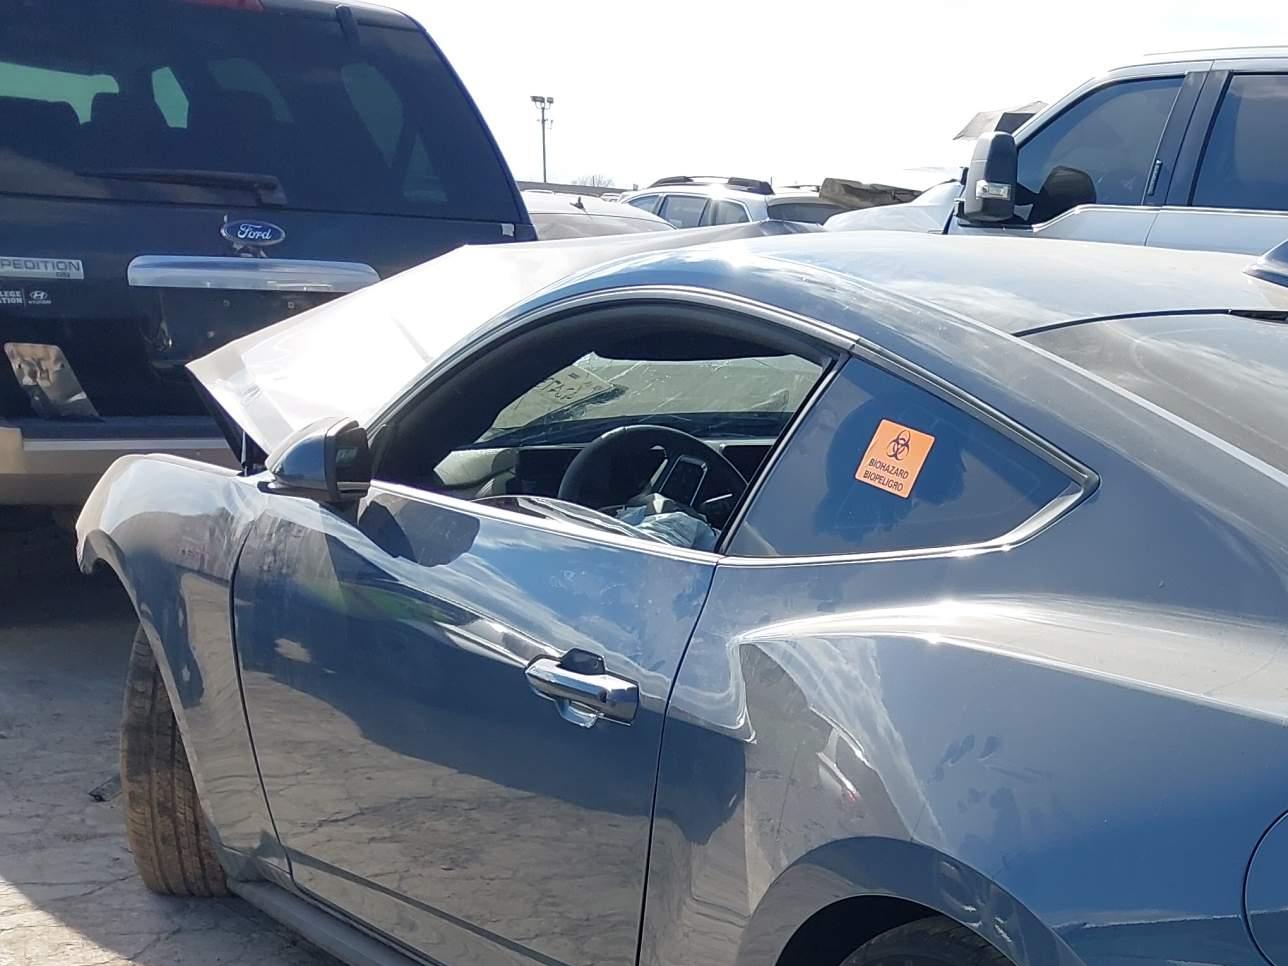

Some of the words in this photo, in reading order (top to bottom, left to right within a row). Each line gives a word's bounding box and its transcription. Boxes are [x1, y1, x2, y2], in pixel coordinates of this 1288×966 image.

[237, 223, 272, 239] Ford
[868, 458, 909, 480] BIOHAZARD
[863, 469, 904, 492] BIOPELIGRO
